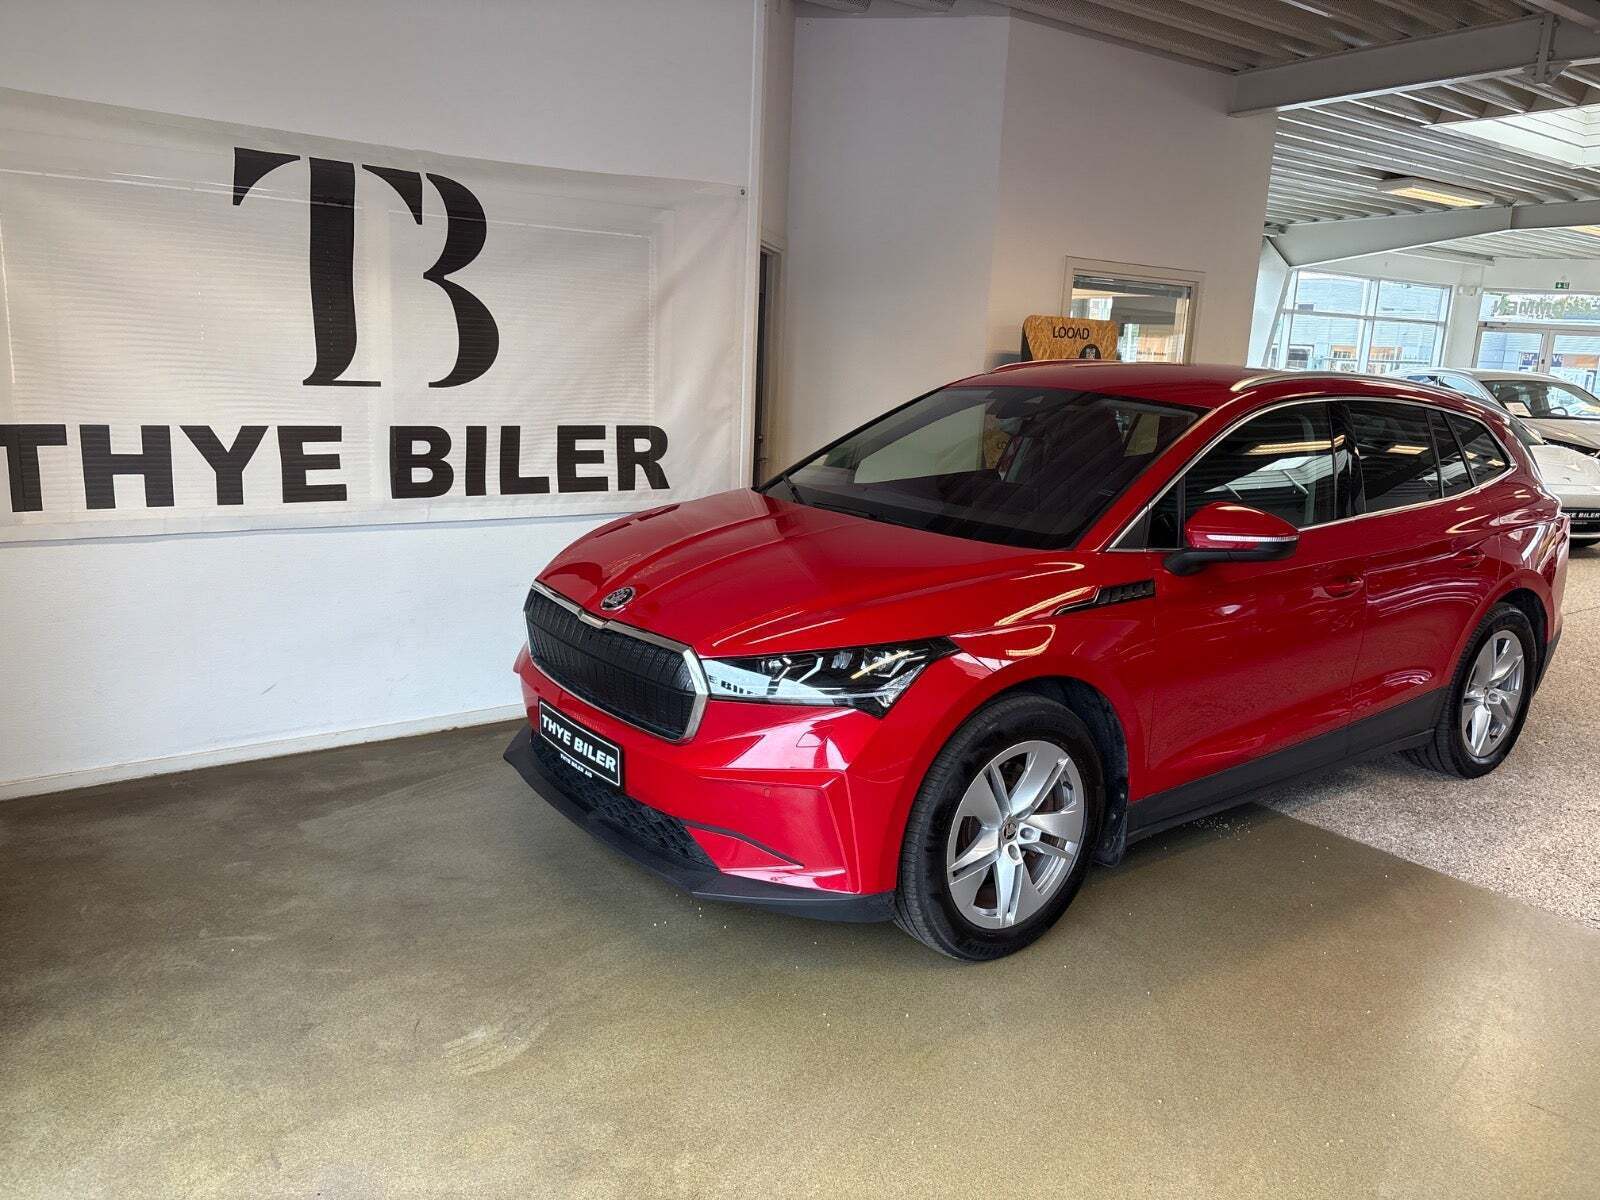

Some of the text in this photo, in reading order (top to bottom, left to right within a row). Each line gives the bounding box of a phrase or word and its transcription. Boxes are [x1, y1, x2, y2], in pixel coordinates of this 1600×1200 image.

[0, 423, 671, 513] THYE BILER
[541, 713, 572, 746] THYE
[573, 736, 616, 773] BILER
